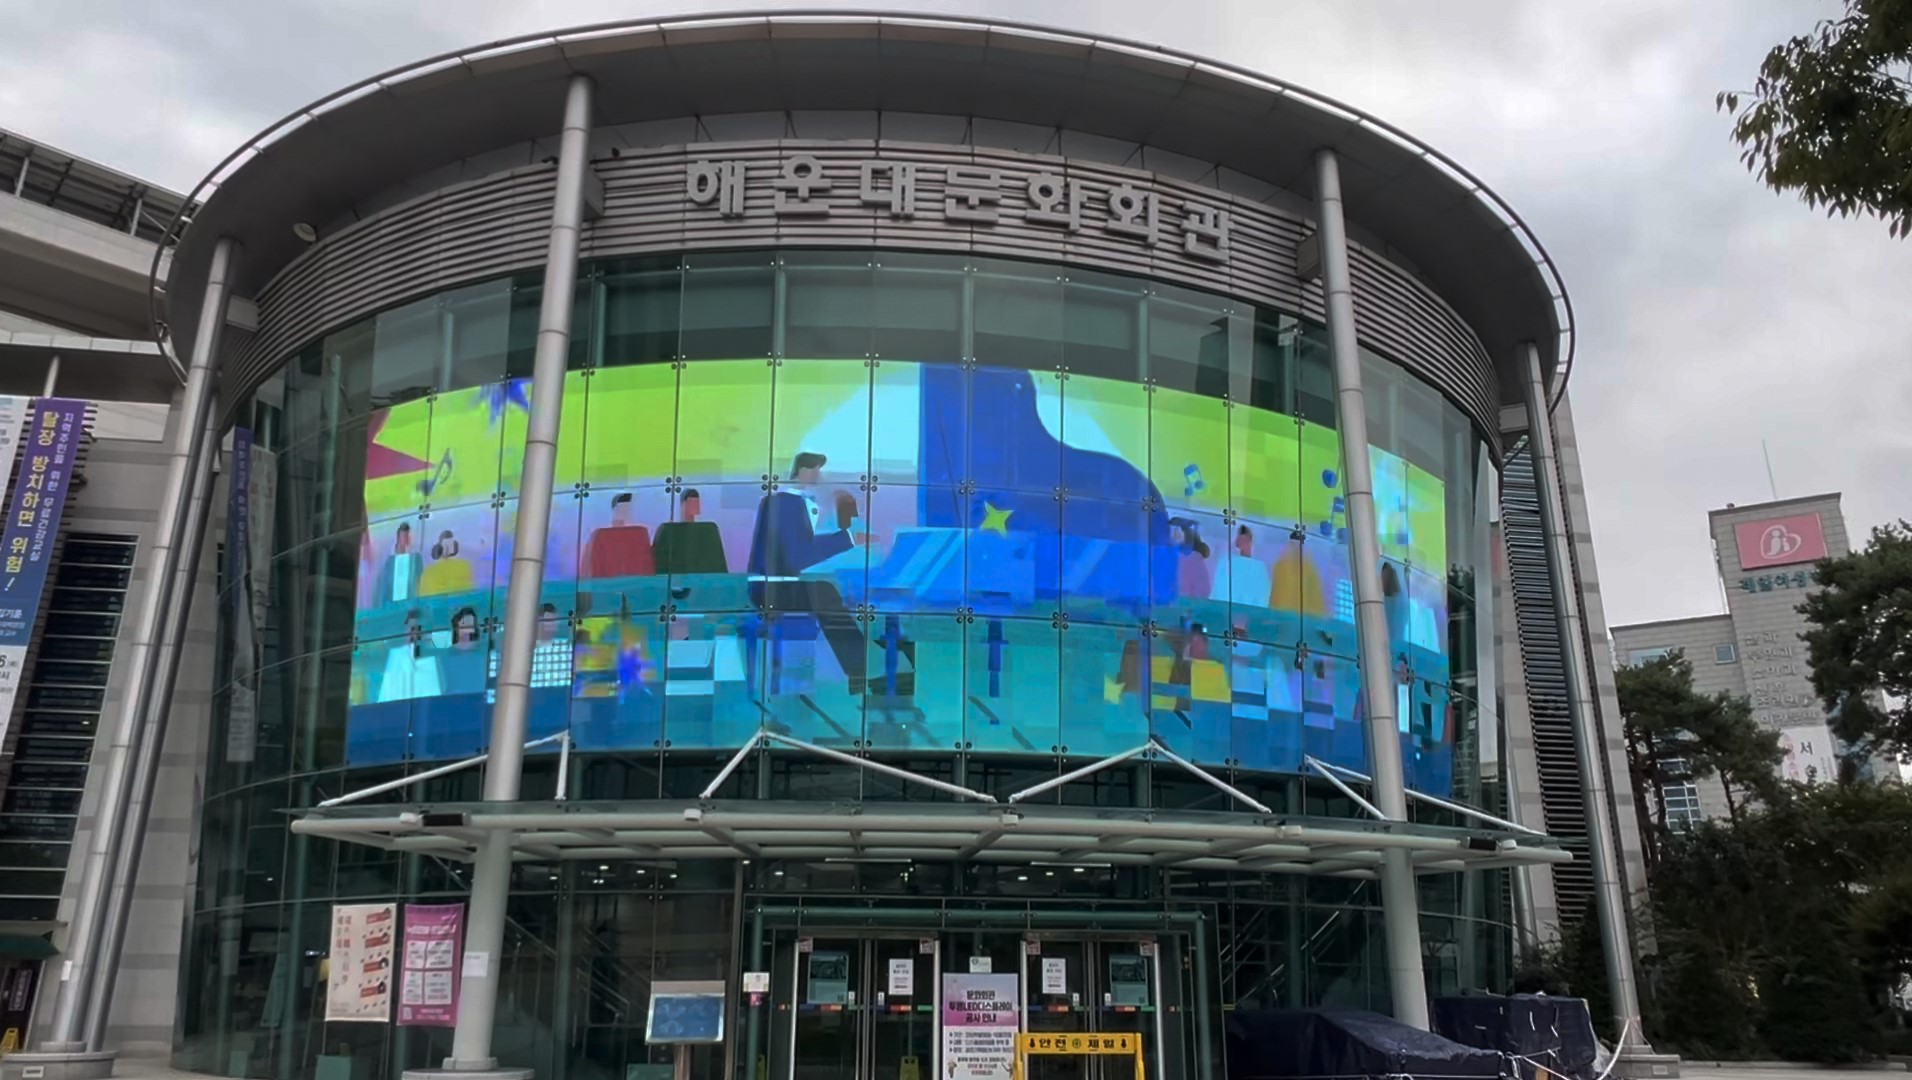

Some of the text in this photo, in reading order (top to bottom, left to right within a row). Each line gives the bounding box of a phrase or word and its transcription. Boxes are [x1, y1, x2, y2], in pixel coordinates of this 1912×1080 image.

[686, 154, 1233, 264] 해운대문화회관
[17, 455, 50, 527] 방치하면
[1039, 1038, 1066, 1049] 안전
